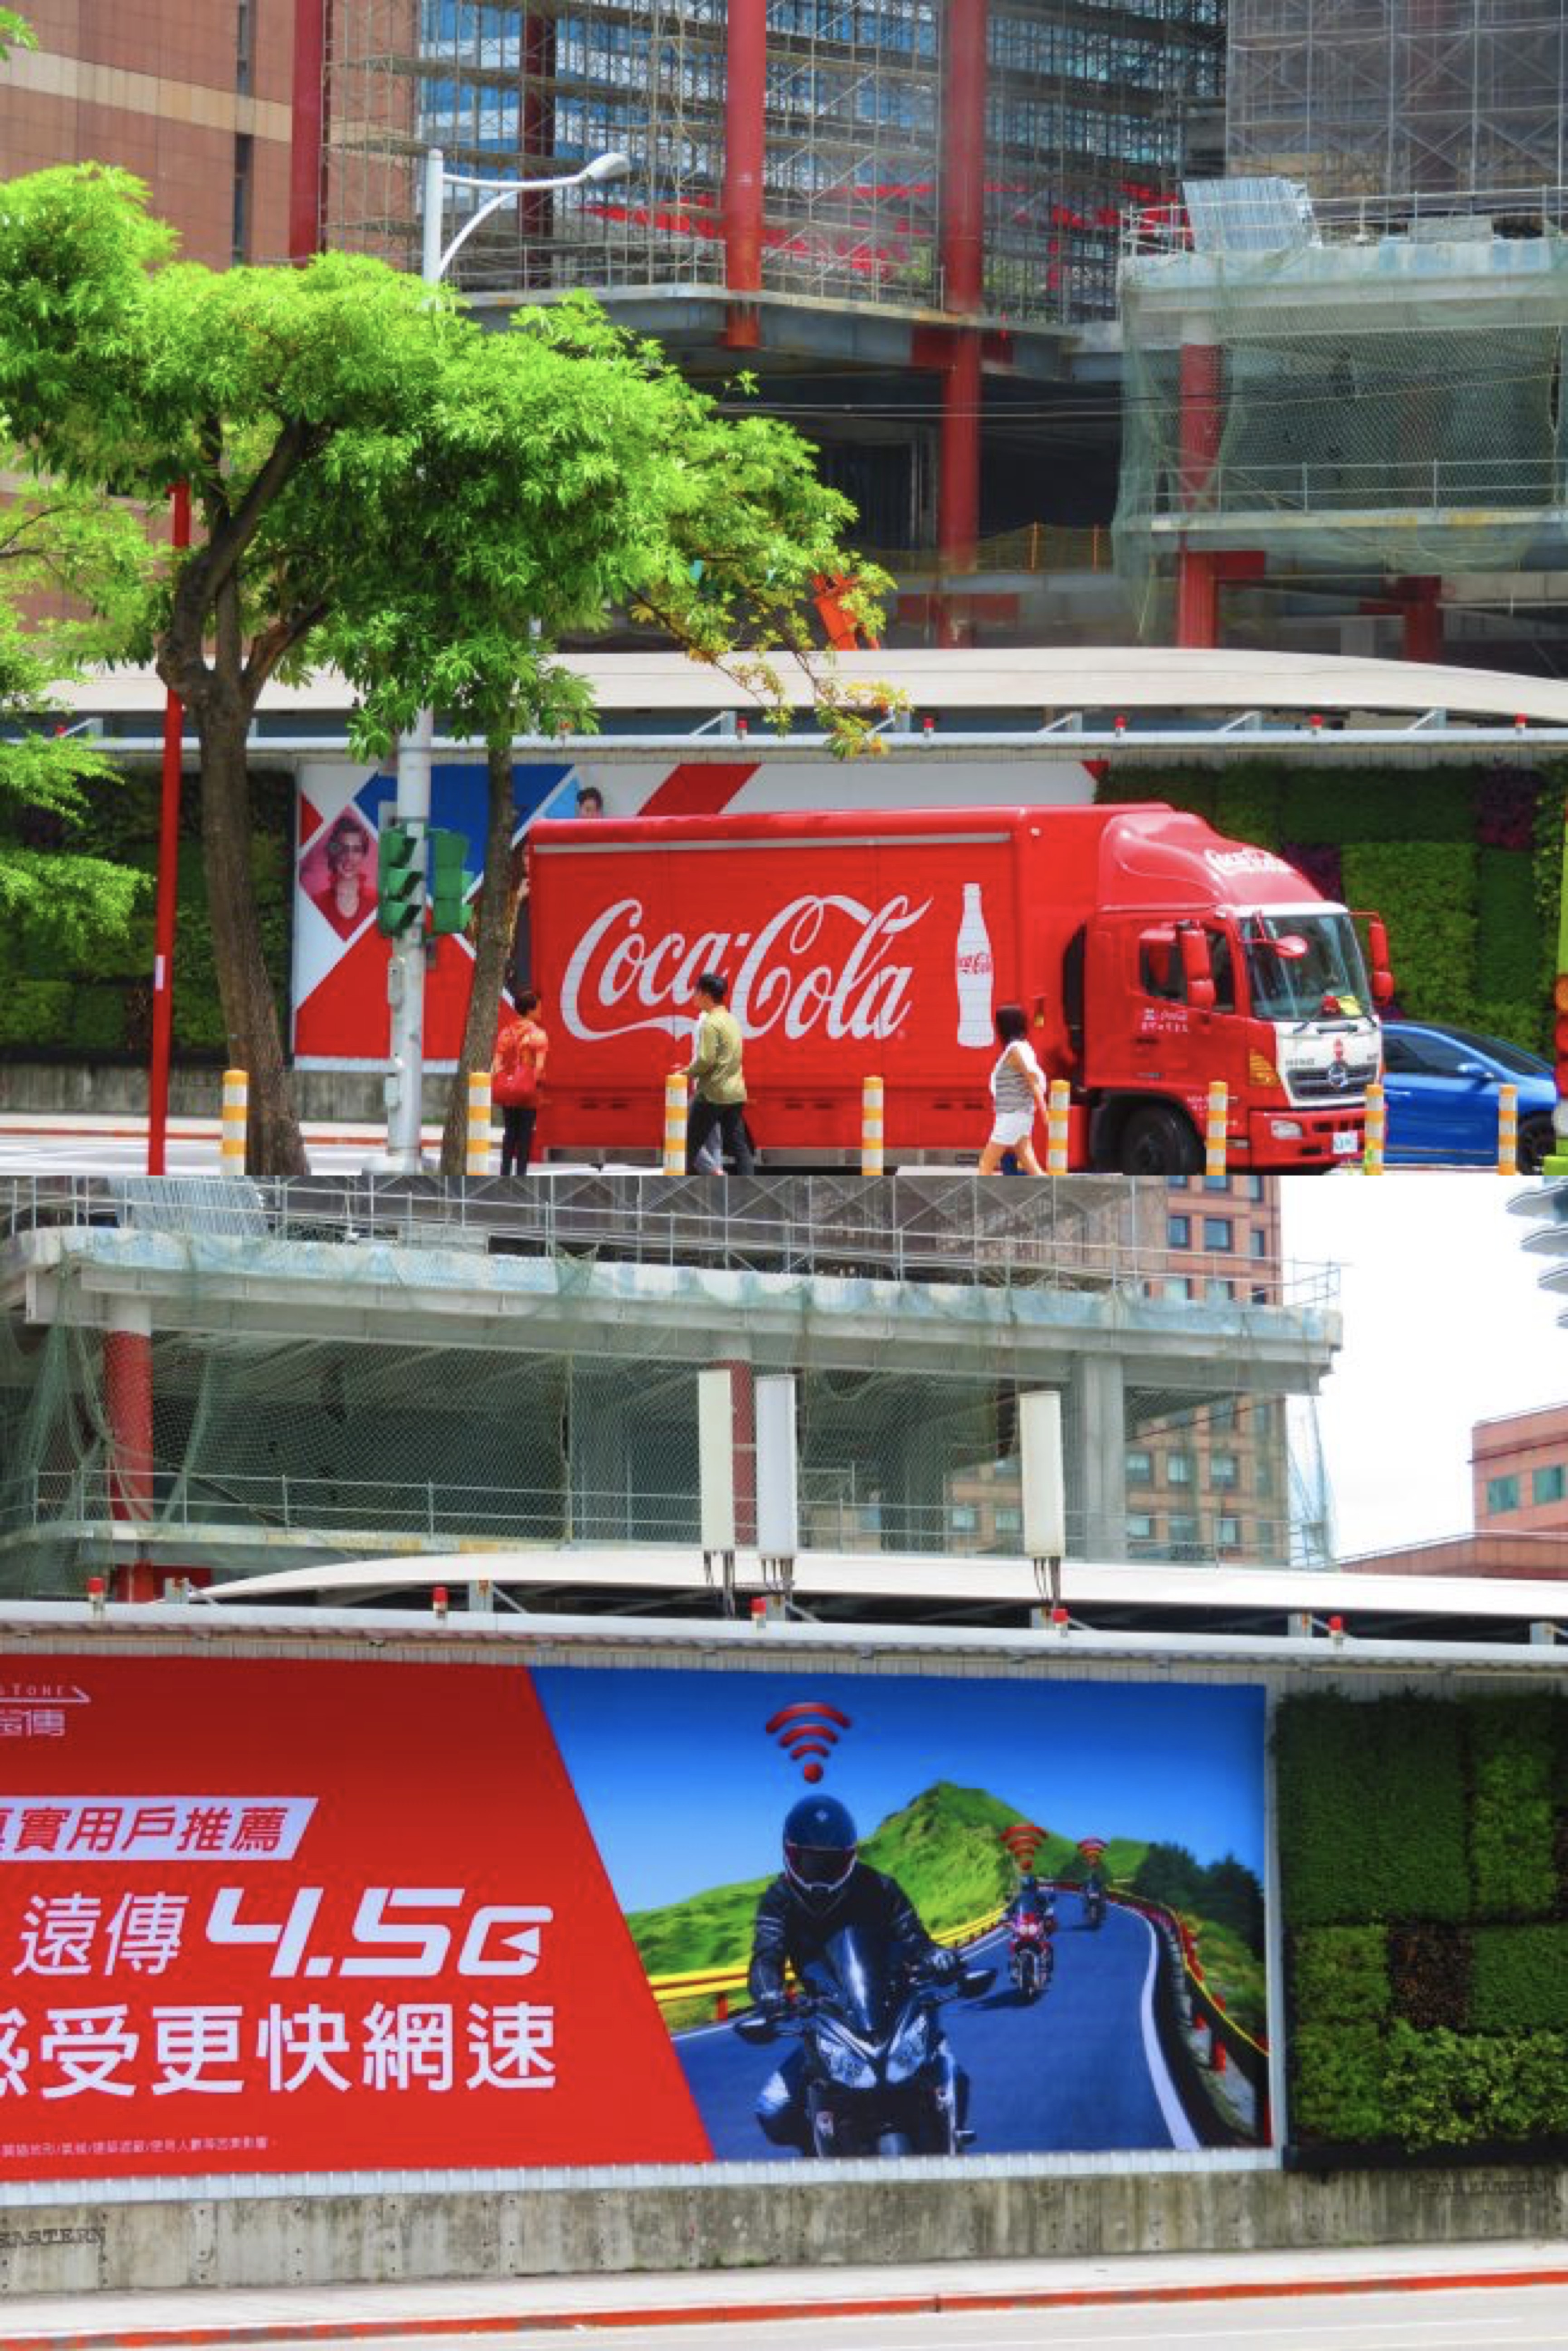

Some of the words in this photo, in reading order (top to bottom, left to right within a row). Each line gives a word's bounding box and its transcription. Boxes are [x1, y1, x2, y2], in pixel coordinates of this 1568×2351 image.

[560, 894, 933, 1041] Coca-Cola
[0, 1806, 289, 1853] 實用戶推薦
[12, 1890, 190, 1977] 遠傳
[205, 1888, 554, 1978] 4.5G
